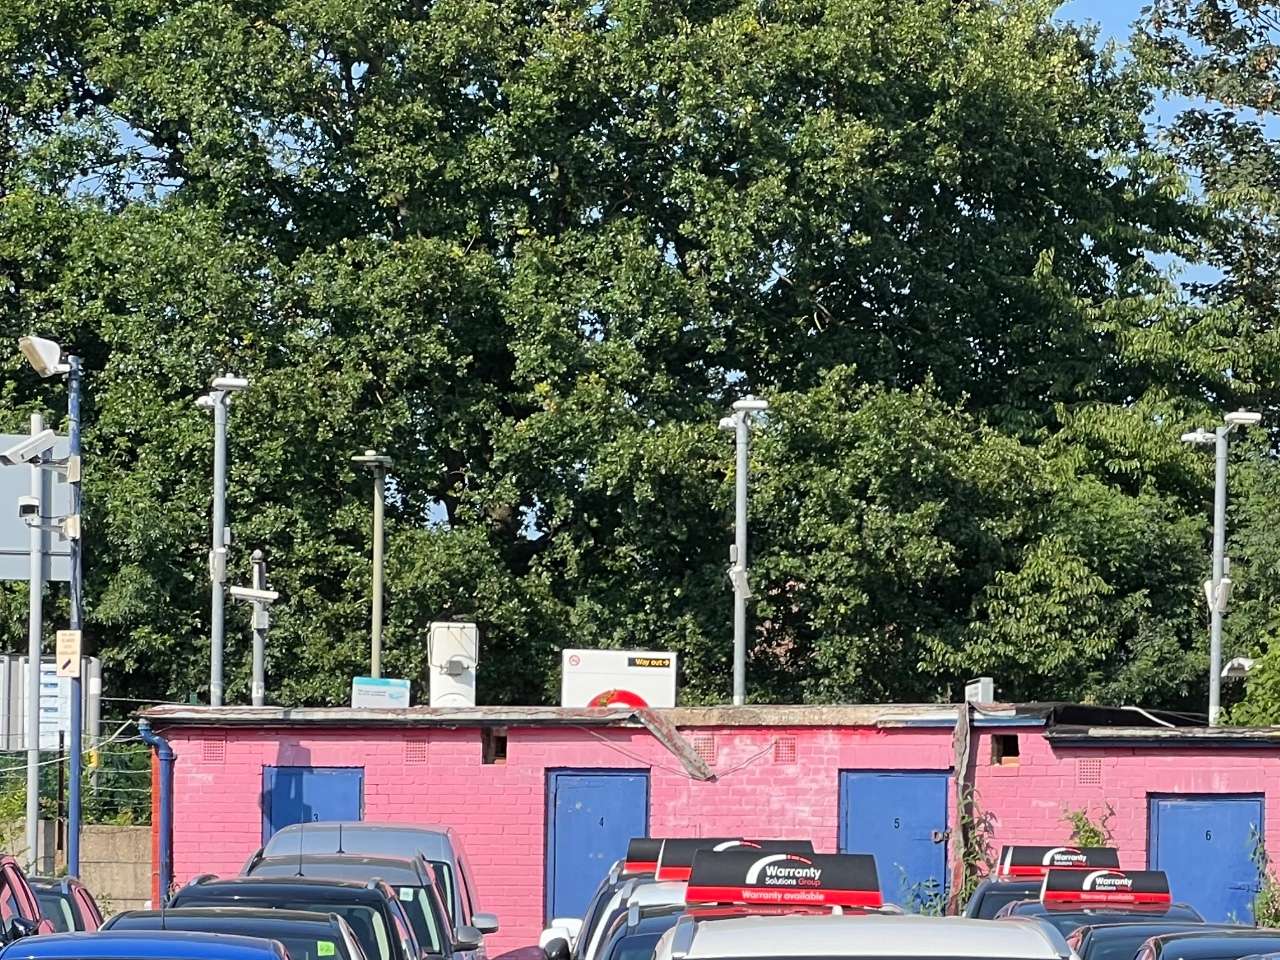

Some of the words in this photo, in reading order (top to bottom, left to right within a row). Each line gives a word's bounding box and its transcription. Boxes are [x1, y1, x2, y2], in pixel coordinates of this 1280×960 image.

[635, 658, 650, 667] Way
[313, 813, 319, 823] 3
[599, 817, 604, 828] 4
[894, 818, 900, 829] 5
[1205, 830, 1212, 841] 6
[1053, 853, 1087, 863] Warranty
[765, 865, 822, 881] Warranty
[765, 877, 797, 885] Solutions
[798, 878, 821, 887] Group
[1095, 877, 1133, 888] Warranty
[742, 890, 783, 901] Warranty
[783, 891, 825, 901] available
